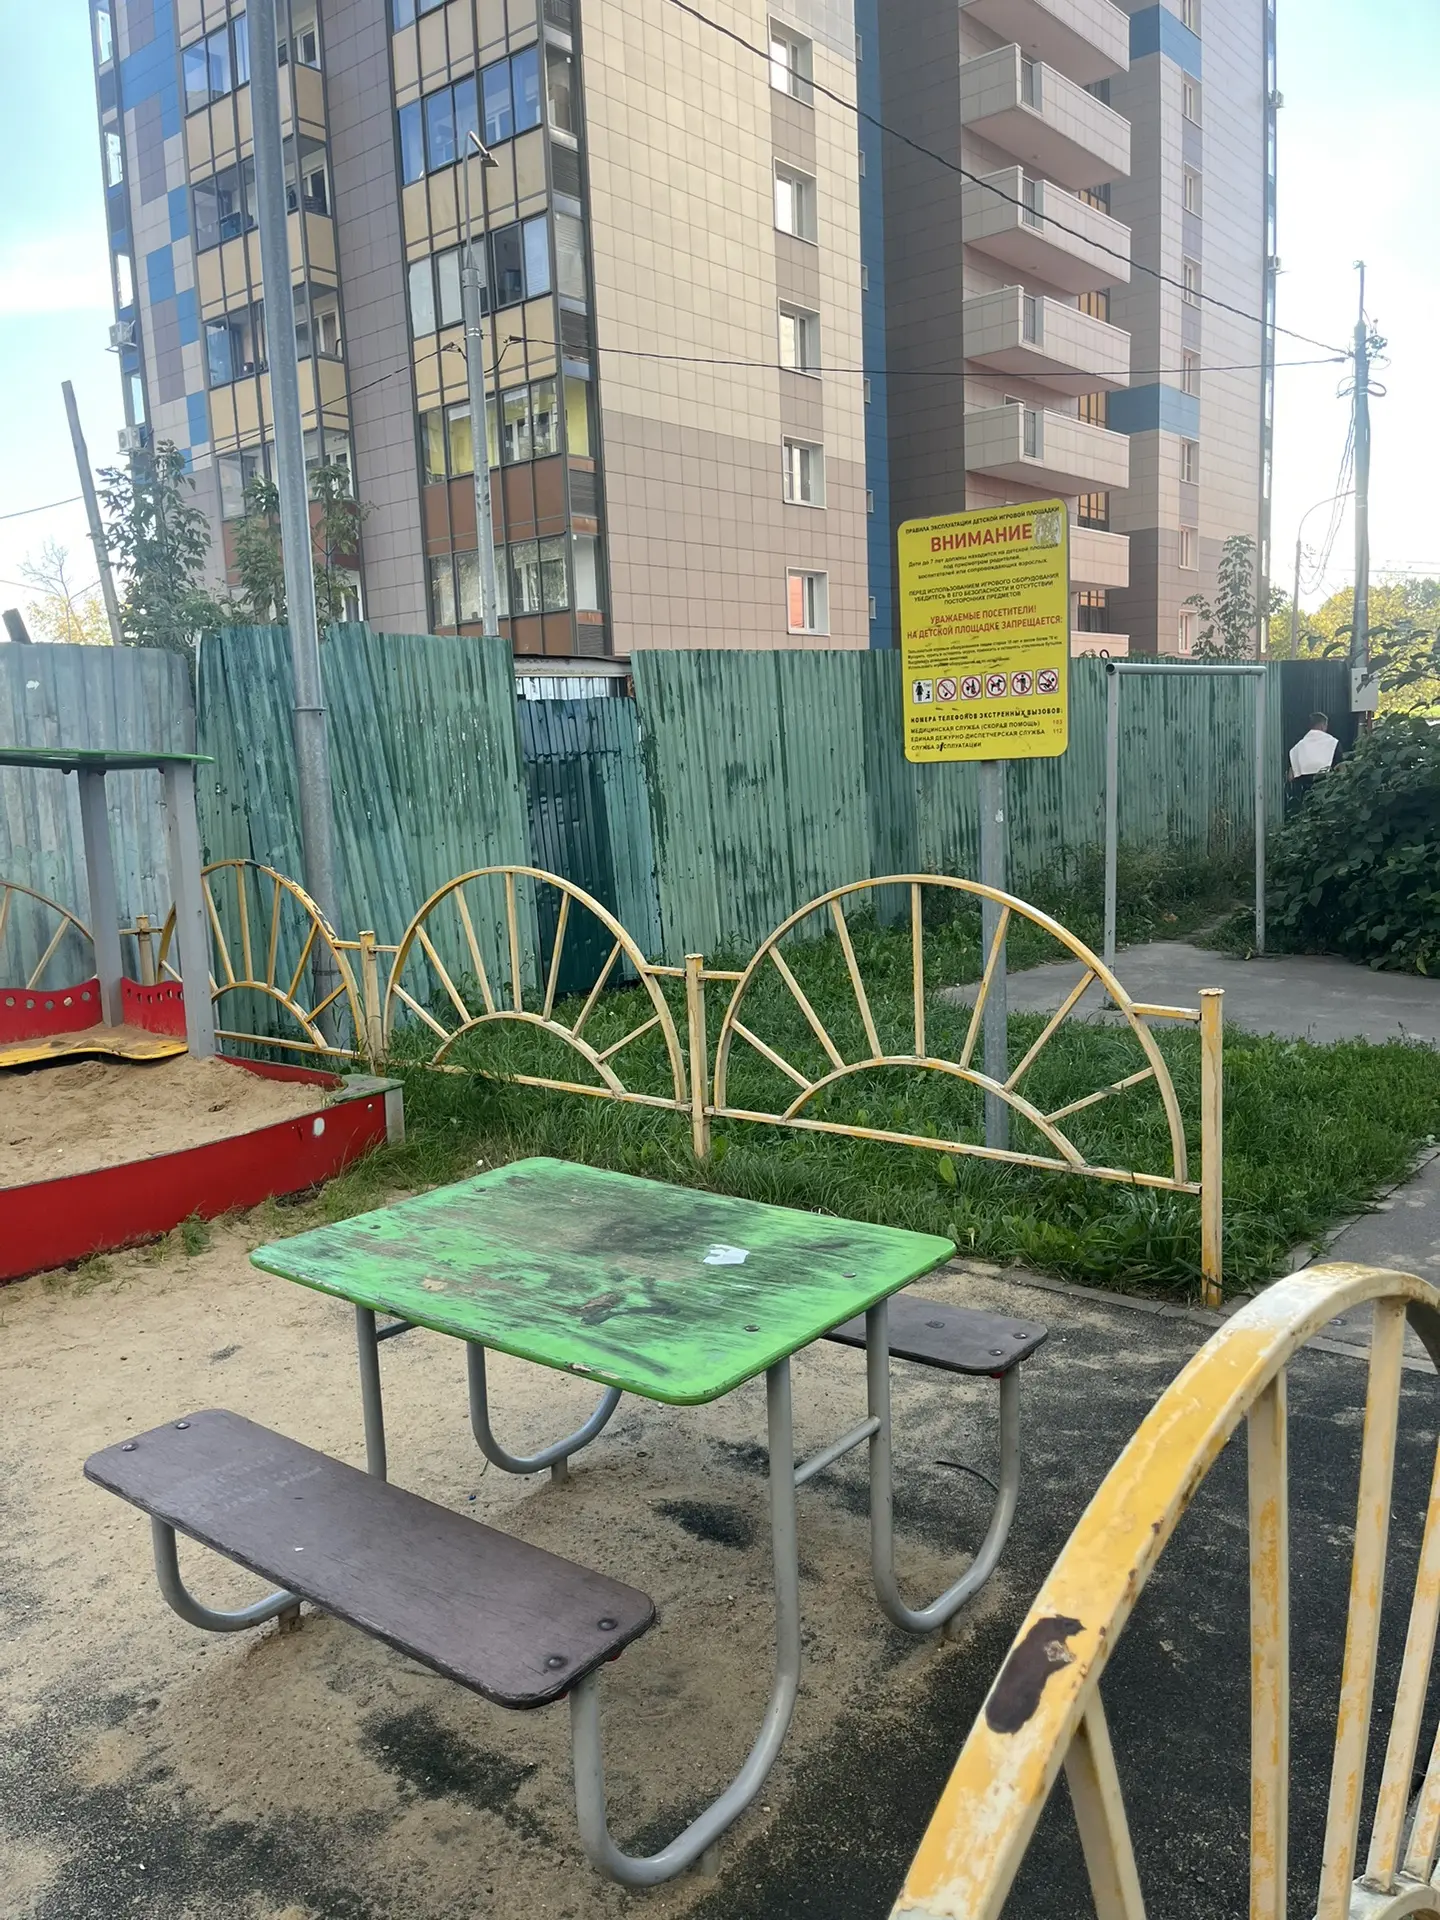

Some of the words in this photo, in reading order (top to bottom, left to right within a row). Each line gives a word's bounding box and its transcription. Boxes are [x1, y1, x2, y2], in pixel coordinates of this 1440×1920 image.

[906, 526, 929, 534] ПРАВИЛА
[931, 520, 971, 530] ЭКСПЛУАТАЦИИ
[973, 515, 998, 524] ДЕТСКОЙ
[999, 511, 1025, 520] ИГРОВОЙ
[1026, 507, 1060, 516] ПЛОЩАДКИ
[931, 523, 1032, 552] ВНИМАНИЕ
[918, 571, 954, 579] воспитателей
[967, 563, 1017, 573] сопровождающих
[955, 560, 988, 568] присмотром
[915, 594, 946, 602] УБЕДИТЕСЬ
[964, 586, 1009, 596] БЕЗОПАСНОСТИ
[1015, 581, 1053, 590] ОТСУТСТВИИ
[928, 583, 979, 594] ИСПОЛЬЗОВАНИЕМ
[981, 579, 1011, 587] ИГРОВОГО
[1012, 573, 1059, 583] ОБОРУДОВАНИЯ
[944, 595, 985, 604] ПОСТОРОННИХ
[987, 591, 1021, 600] ПРЕДМЕТОВ
[930, 611, 981, 624] УВАЖАЕМЫЕ
[983, 605, 1036, 618] ПОСЕТИТЕЛИ!
[907, 631, 917, 639] НА
[919, 626, 953, 639] ДЕТСКОЙ
[955, 622, 999, 634] ПЛОЩАДКЕ
[1002, 615, 1063, 629] ЗАПРЕЩАЕТСЯ:
[938, 713, 978, 721] ТЕЛЕФОНОВ
[979, 710, 1025, 718] ЭКСТРЕННЫХ
[936, 742, 982, 751] ЭСПЛУАТАЦИИ
